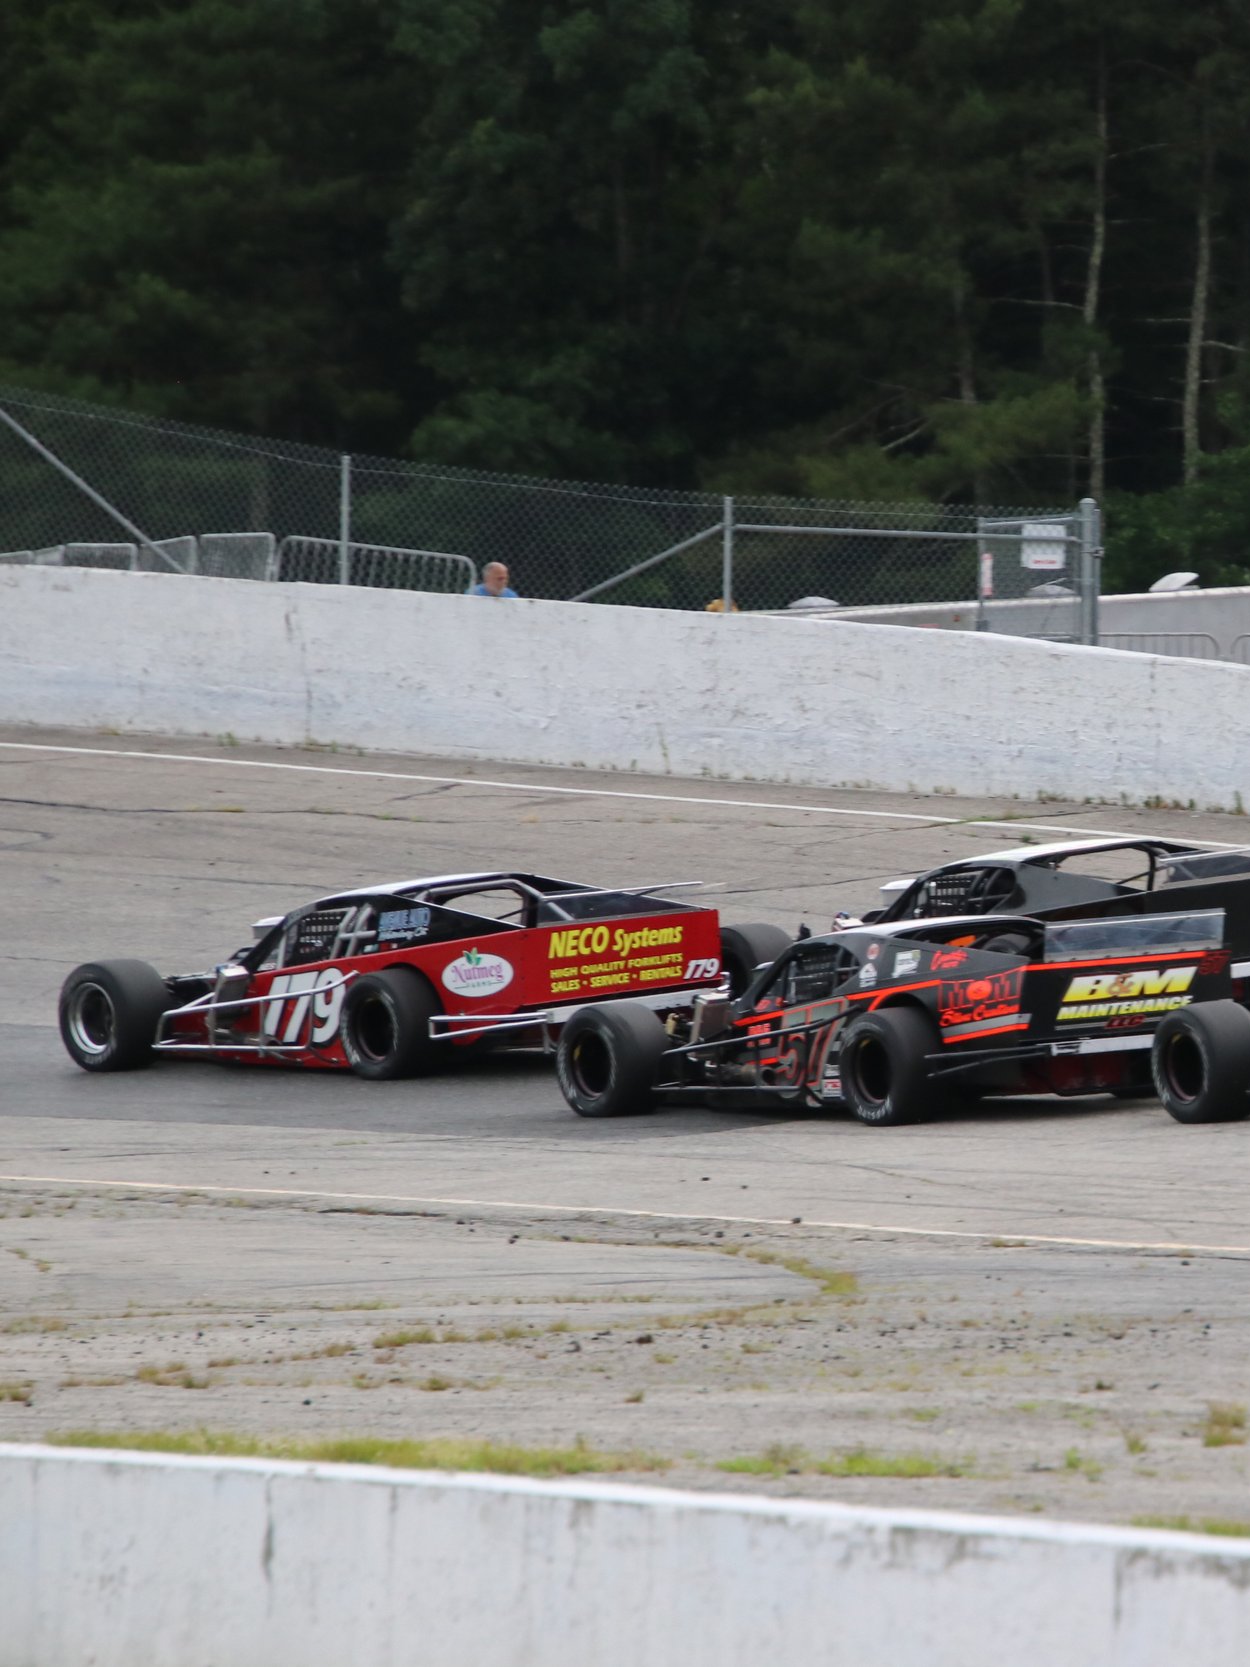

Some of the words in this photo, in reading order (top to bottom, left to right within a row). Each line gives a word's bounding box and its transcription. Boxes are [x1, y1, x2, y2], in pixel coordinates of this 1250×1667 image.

[548, 926, 610, 959] NECO
[612, 926, 683, 957] Systems
[452, 962, 504, 983] Nutmeg
[550, 967, 578, 979] HIGH
[580, 960, 626, 975] QUALITY
[627, 953, 683, 969] FORKLIFTS
[683, 958, 719, 980] 179
[551, 979, 580, 993] SALES
[590, 973, 630, 988] SERVICE
[639, 966, 682, 981] RENTALS
[1062, 966, 1199, 1002] B&M
[263, 967, 347, 1045] 179
[1056, 995, 1194, 1021] MAINTENANCE
